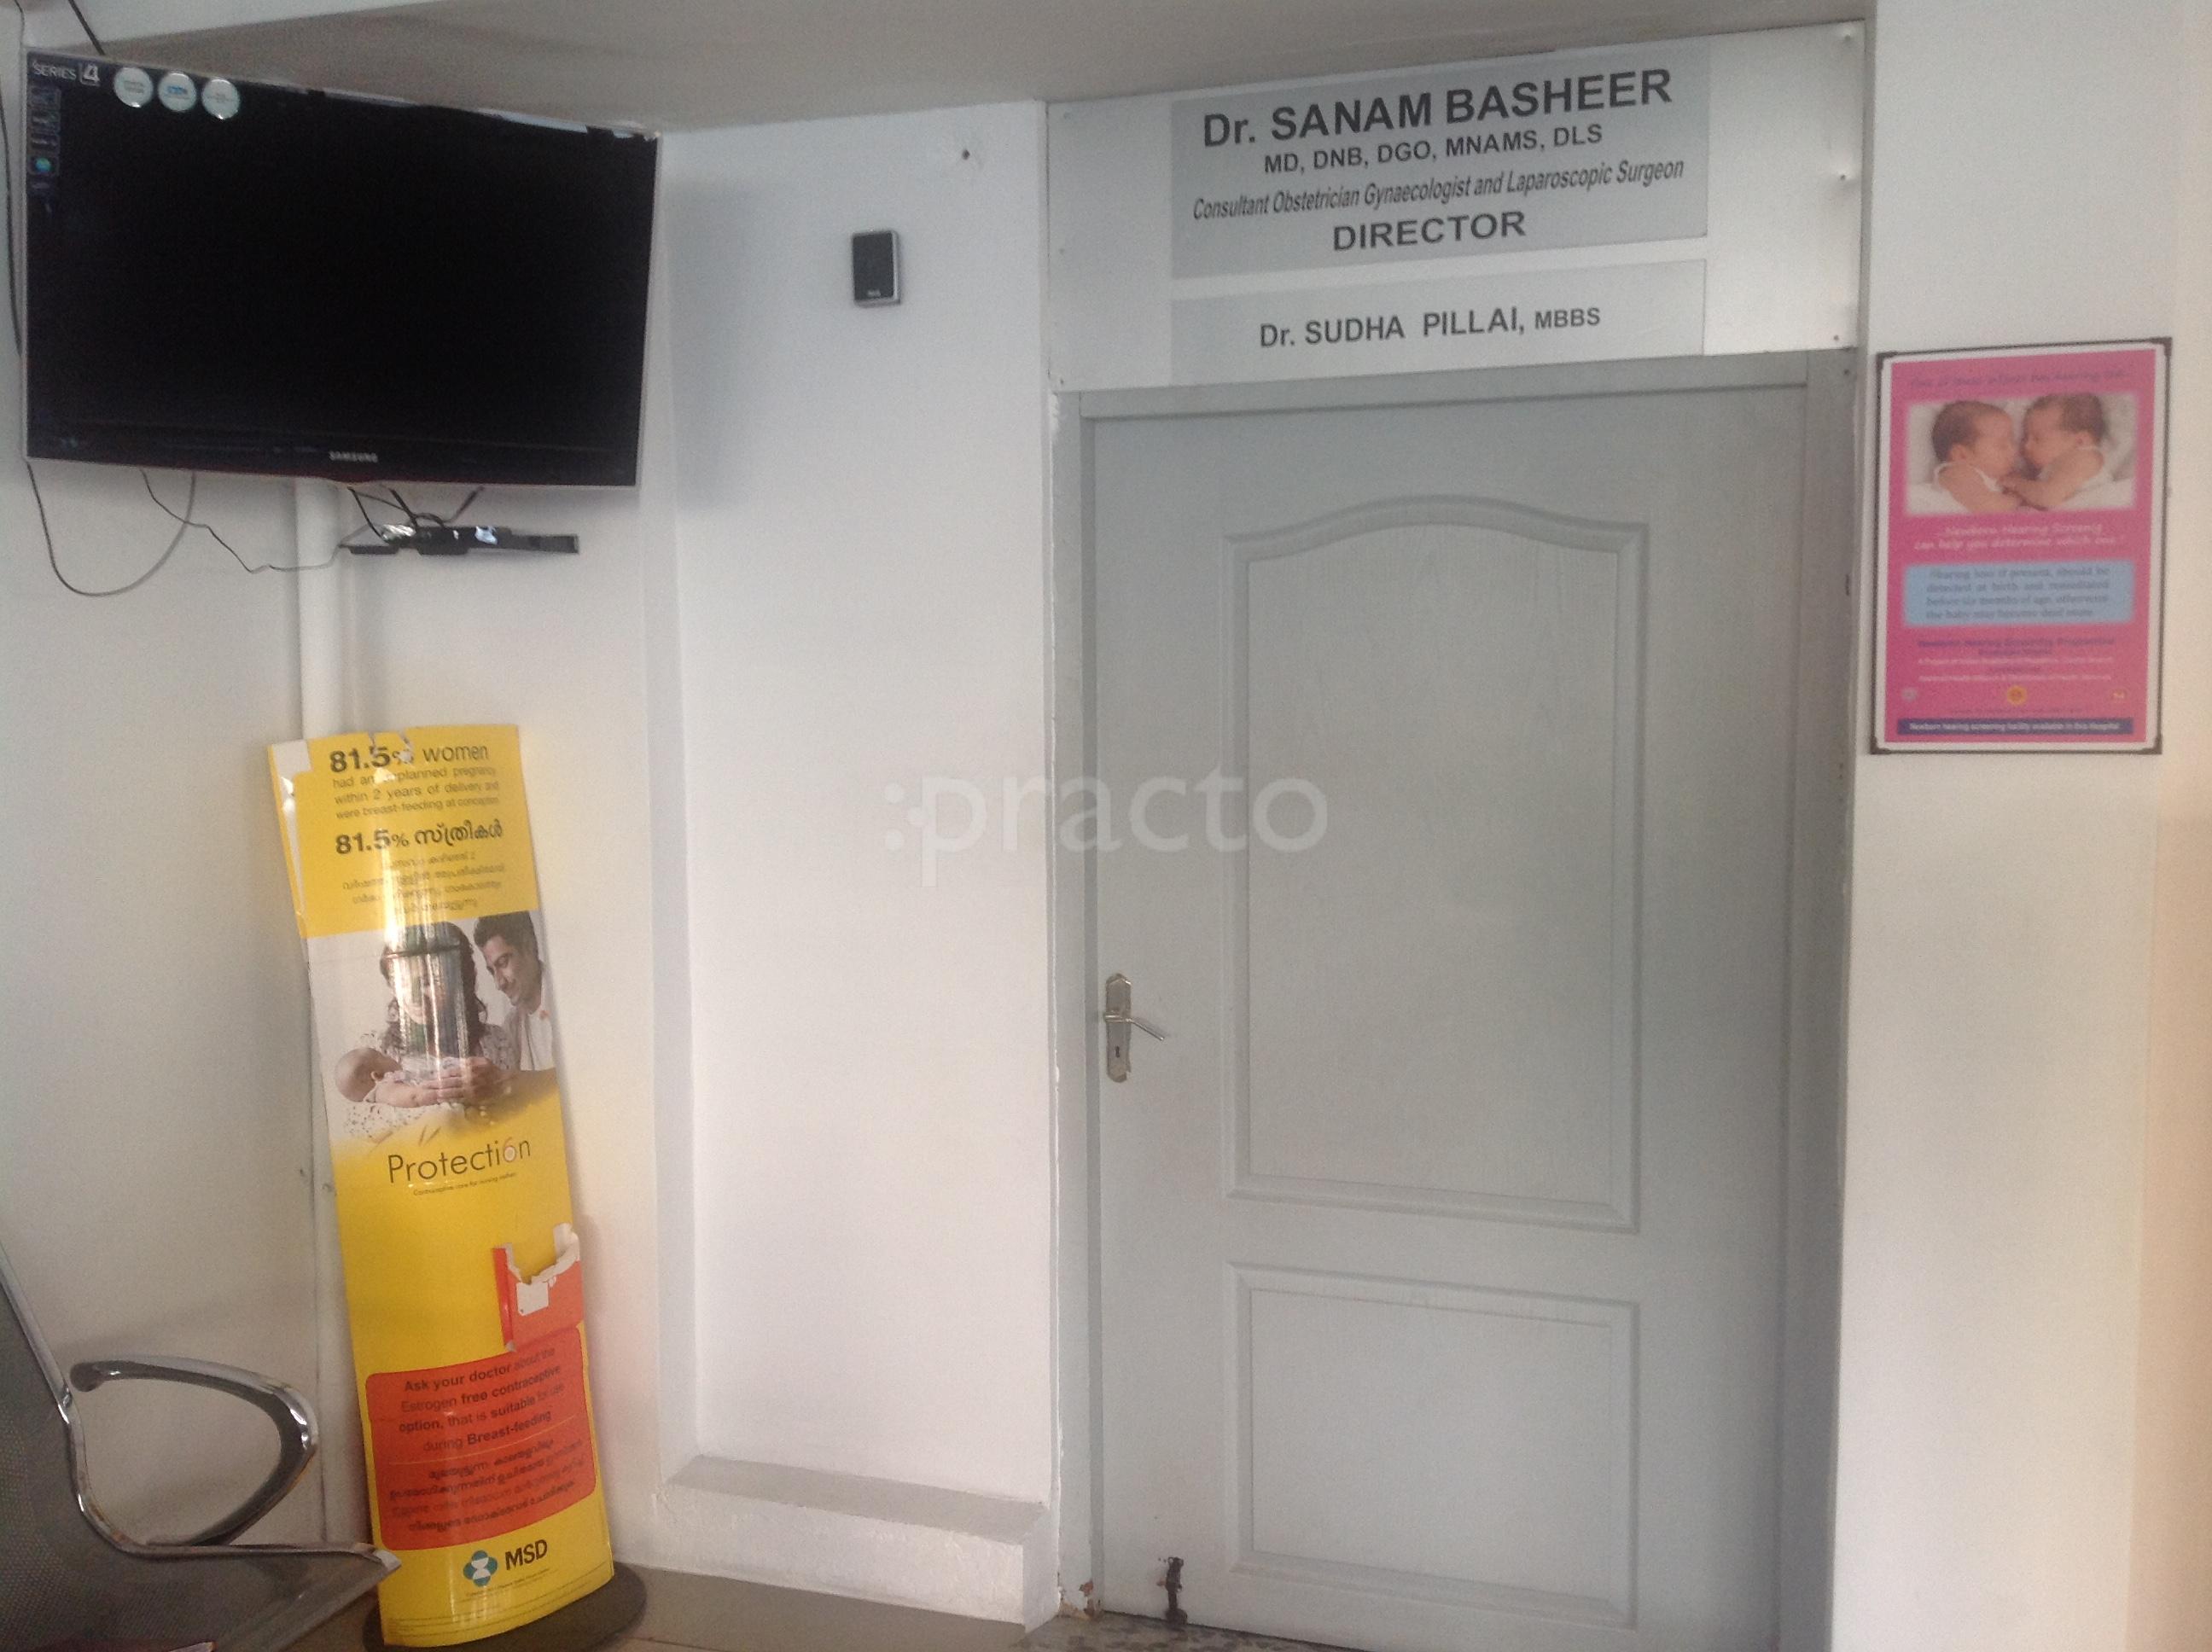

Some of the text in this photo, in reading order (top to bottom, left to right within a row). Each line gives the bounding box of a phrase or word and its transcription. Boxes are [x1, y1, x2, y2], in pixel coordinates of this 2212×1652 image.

[34, 62, 100, 82] SERIES 4
[1204, 68, 1673, 147] Dr. SANAM BASHEER
[1265, 123, 1603, 175] MD, DNB, DGO, MNAMS, DLS
[1193, 157, 1685, 220] Consultant Obstetrician Gynaecologist and Laparoscopic Surgeon
[1333, 210, 1526, 251] DIRECTOR
[1260, 305, 1601, 348] Dr. SUDHA PILLAI, MBBS
[422, 745, 489, 763] women
[333, 775, 355, 788] had
[335, 792, 370, 805] within
[373, 788, 381, 800] 2
[387, 785, 422, 800] years
[428, 783, 440, 795] of
[335, 828, 410, 855] 81.5%
[387, 1137, 532, 1184] Protection
[401, 1364, 562, 1413] Estrogen free contraceptive
[404, 1379, 429, 1392] Ask
[434, 1374, 465, 1391] your
[469, 1364, 512, 1382] doctor
[399, 1419, 445, 1434] option,
[448, 1413, 473, 1428] that
[476, 1411, 487, 1422] is
[491, 1396, 536, 1419] suitable
[423, 1410, 552, 1452] during Breast-feeding
[504, 1539, 548, 1571] MSD
